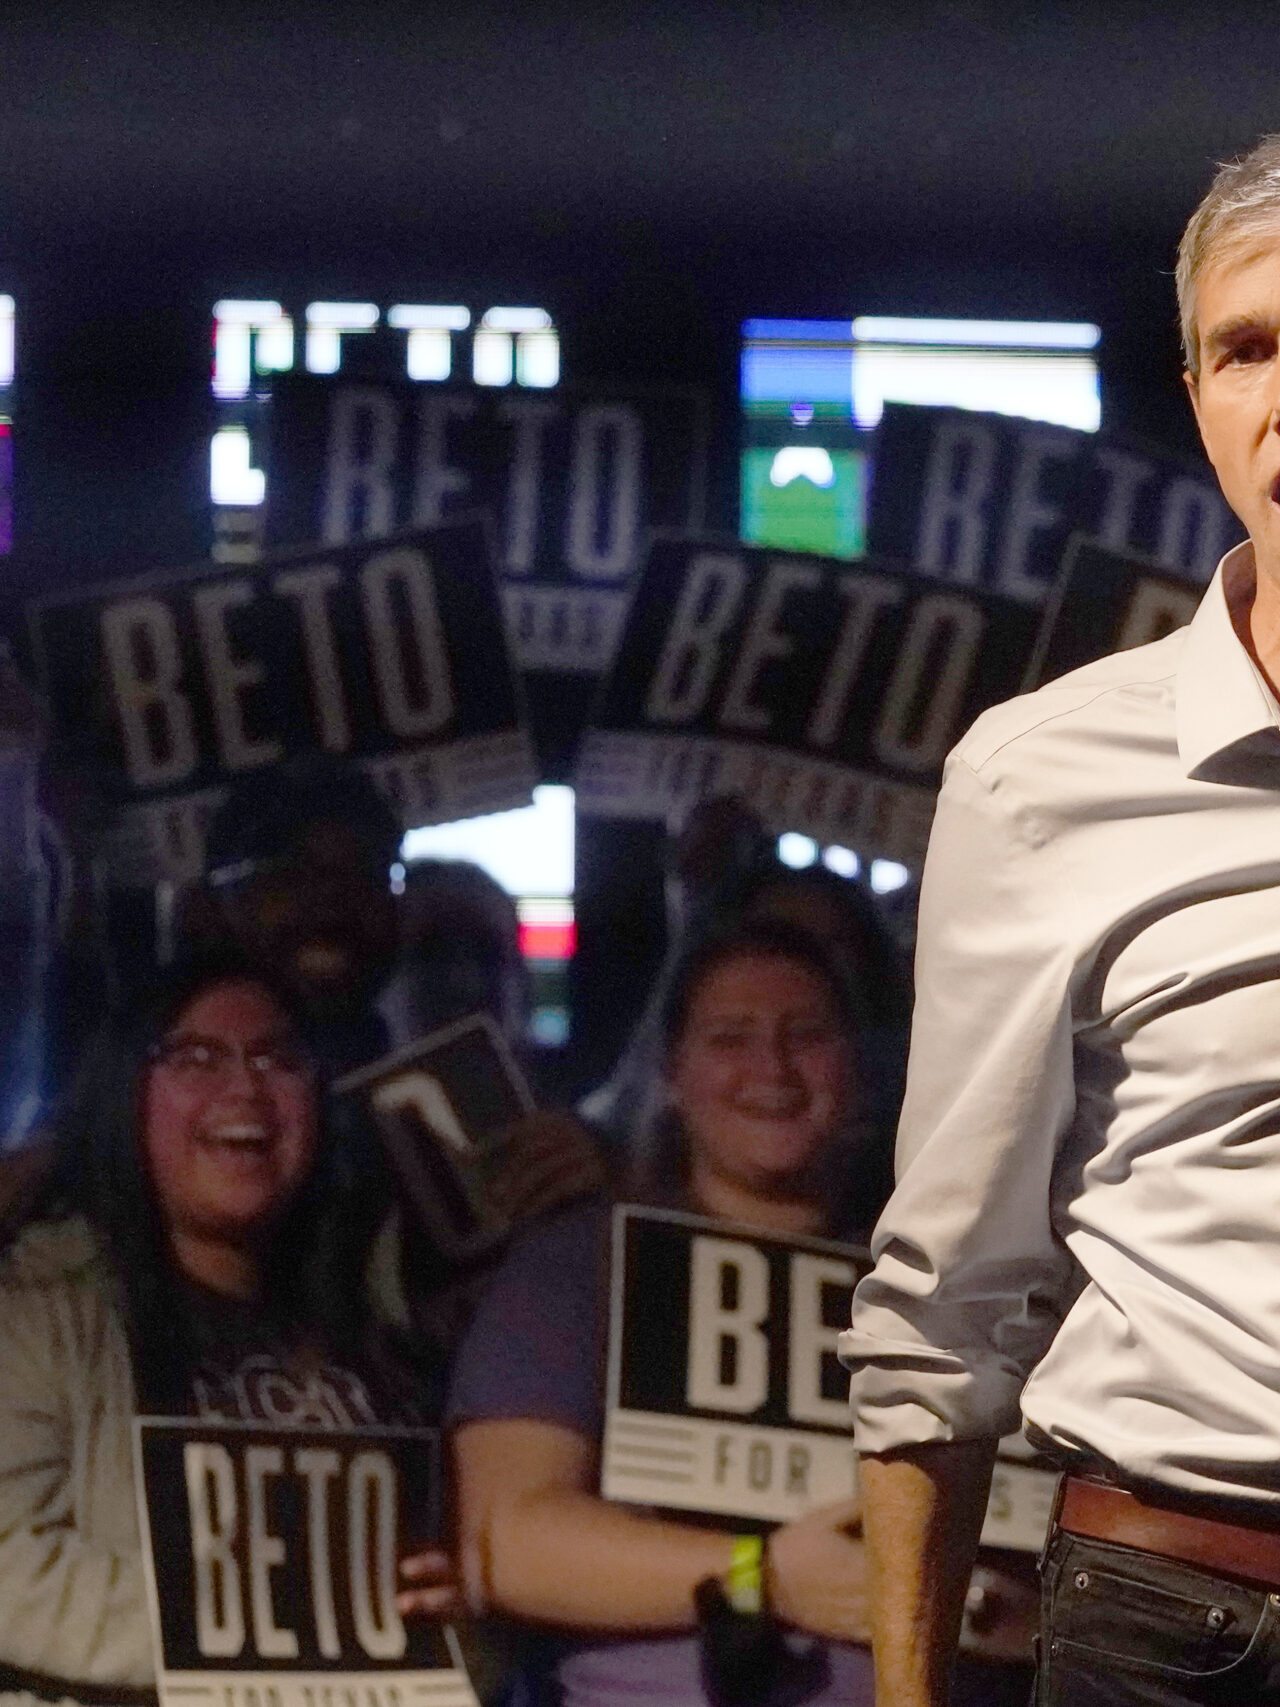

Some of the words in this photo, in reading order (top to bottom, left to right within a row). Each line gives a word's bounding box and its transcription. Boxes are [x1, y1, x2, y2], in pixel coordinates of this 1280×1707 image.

[102, 546, 457, 787] BETO
[644, 553, 989, 771] BETO
[685, 1233, 858, 1424] BE
[182, 1440, 408, 1661] BETO
[714, 1434, 811, 1496] FOR
